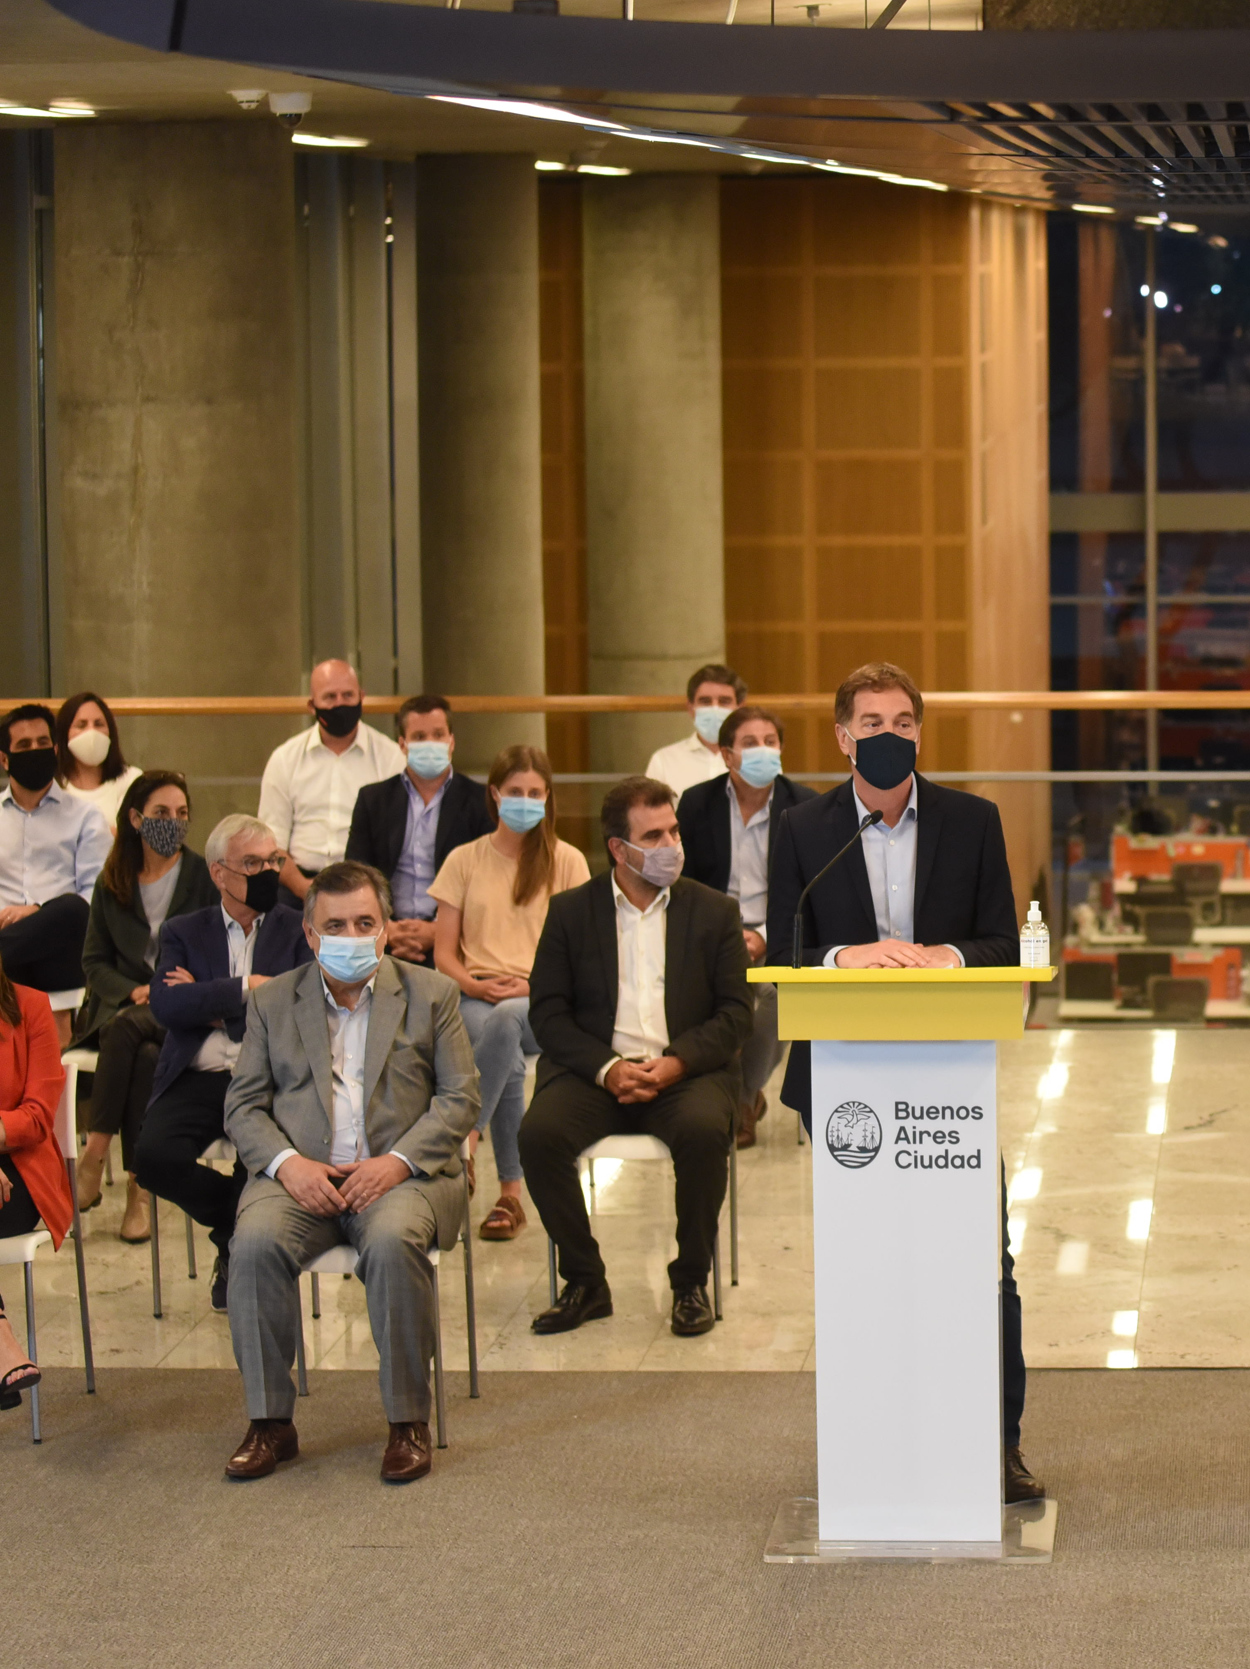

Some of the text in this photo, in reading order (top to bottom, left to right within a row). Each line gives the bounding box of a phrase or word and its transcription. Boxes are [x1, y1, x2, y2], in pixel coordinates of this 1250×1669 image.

[894, 1101, 984, 1121] Buenos
[894, 1125, 961, 1145] Aires
[894, 1148, 982, 1169] Ciudad
